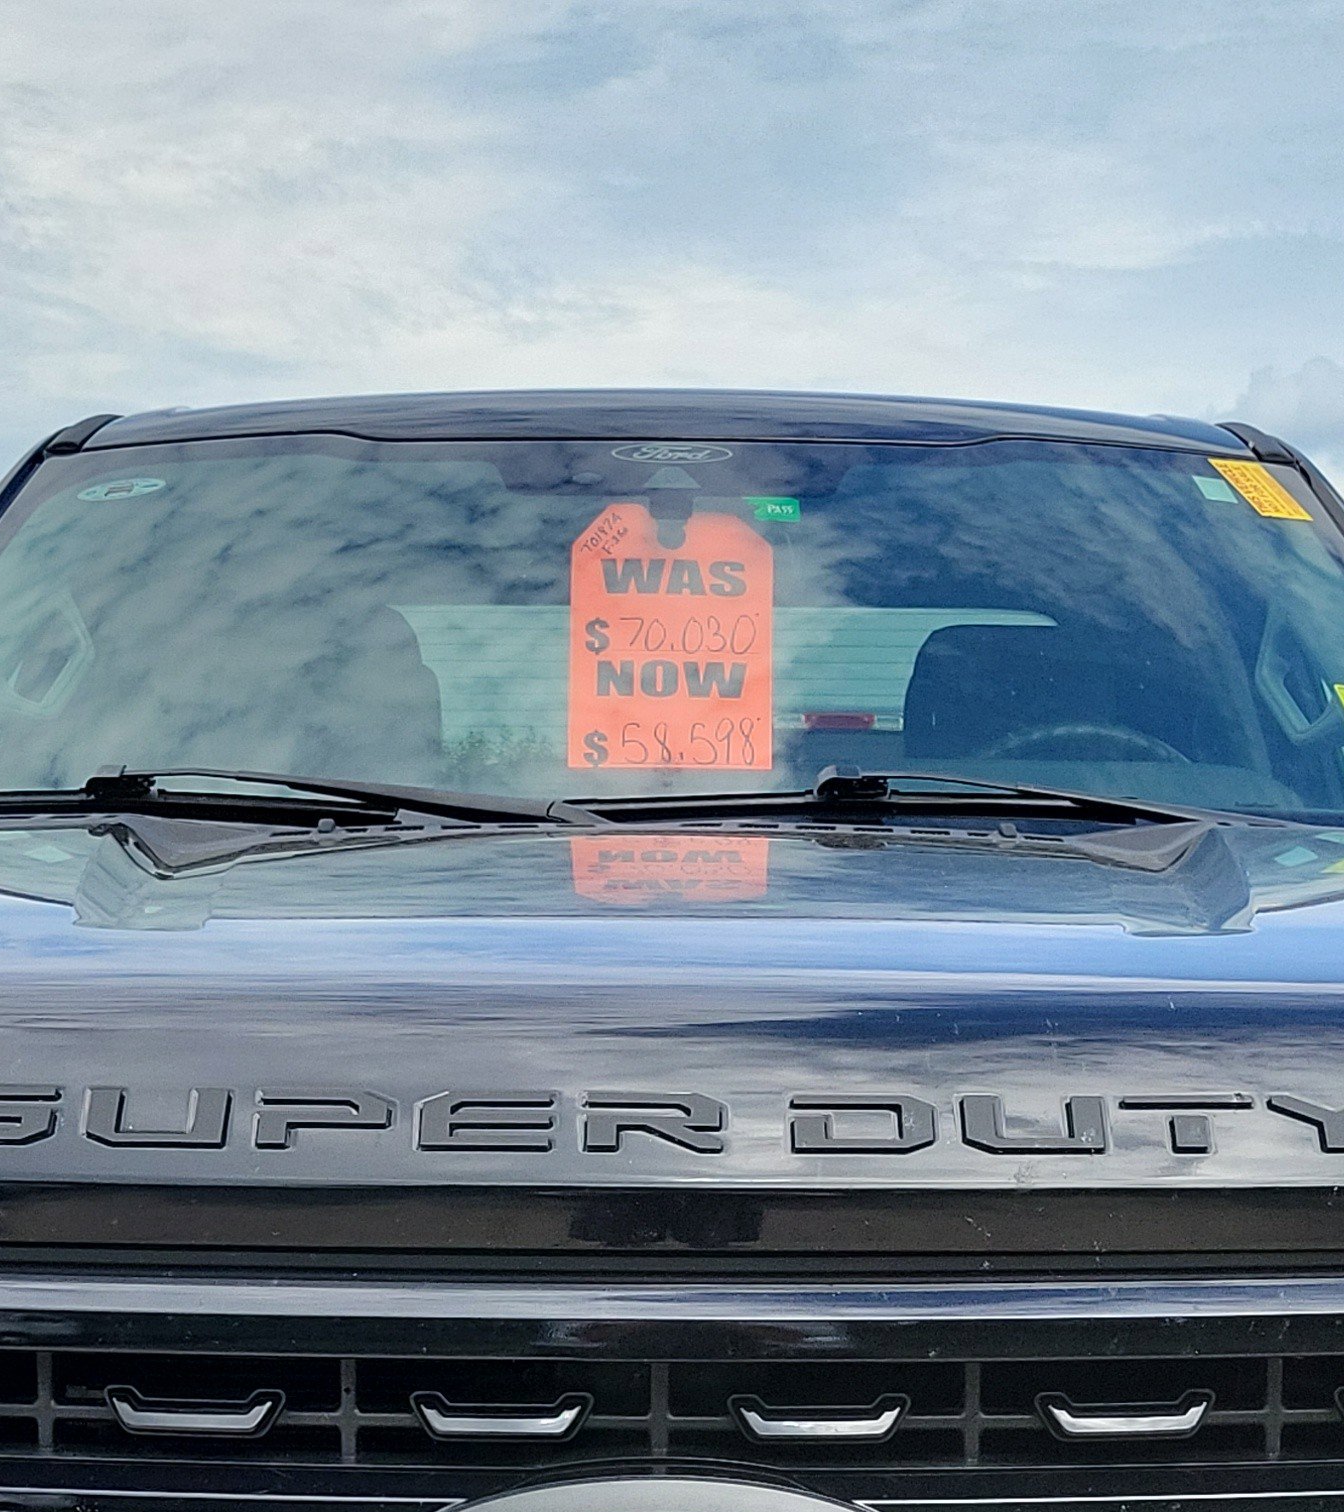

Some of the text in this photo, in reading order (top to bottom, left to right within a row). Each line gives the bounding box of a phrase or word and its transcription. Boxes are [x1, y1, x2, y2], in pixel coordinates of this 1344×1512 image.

[632, 445, 711, 460] Ford
[600, 558, 748, 597] WAS
[596, 658, 748, 699] NOW
